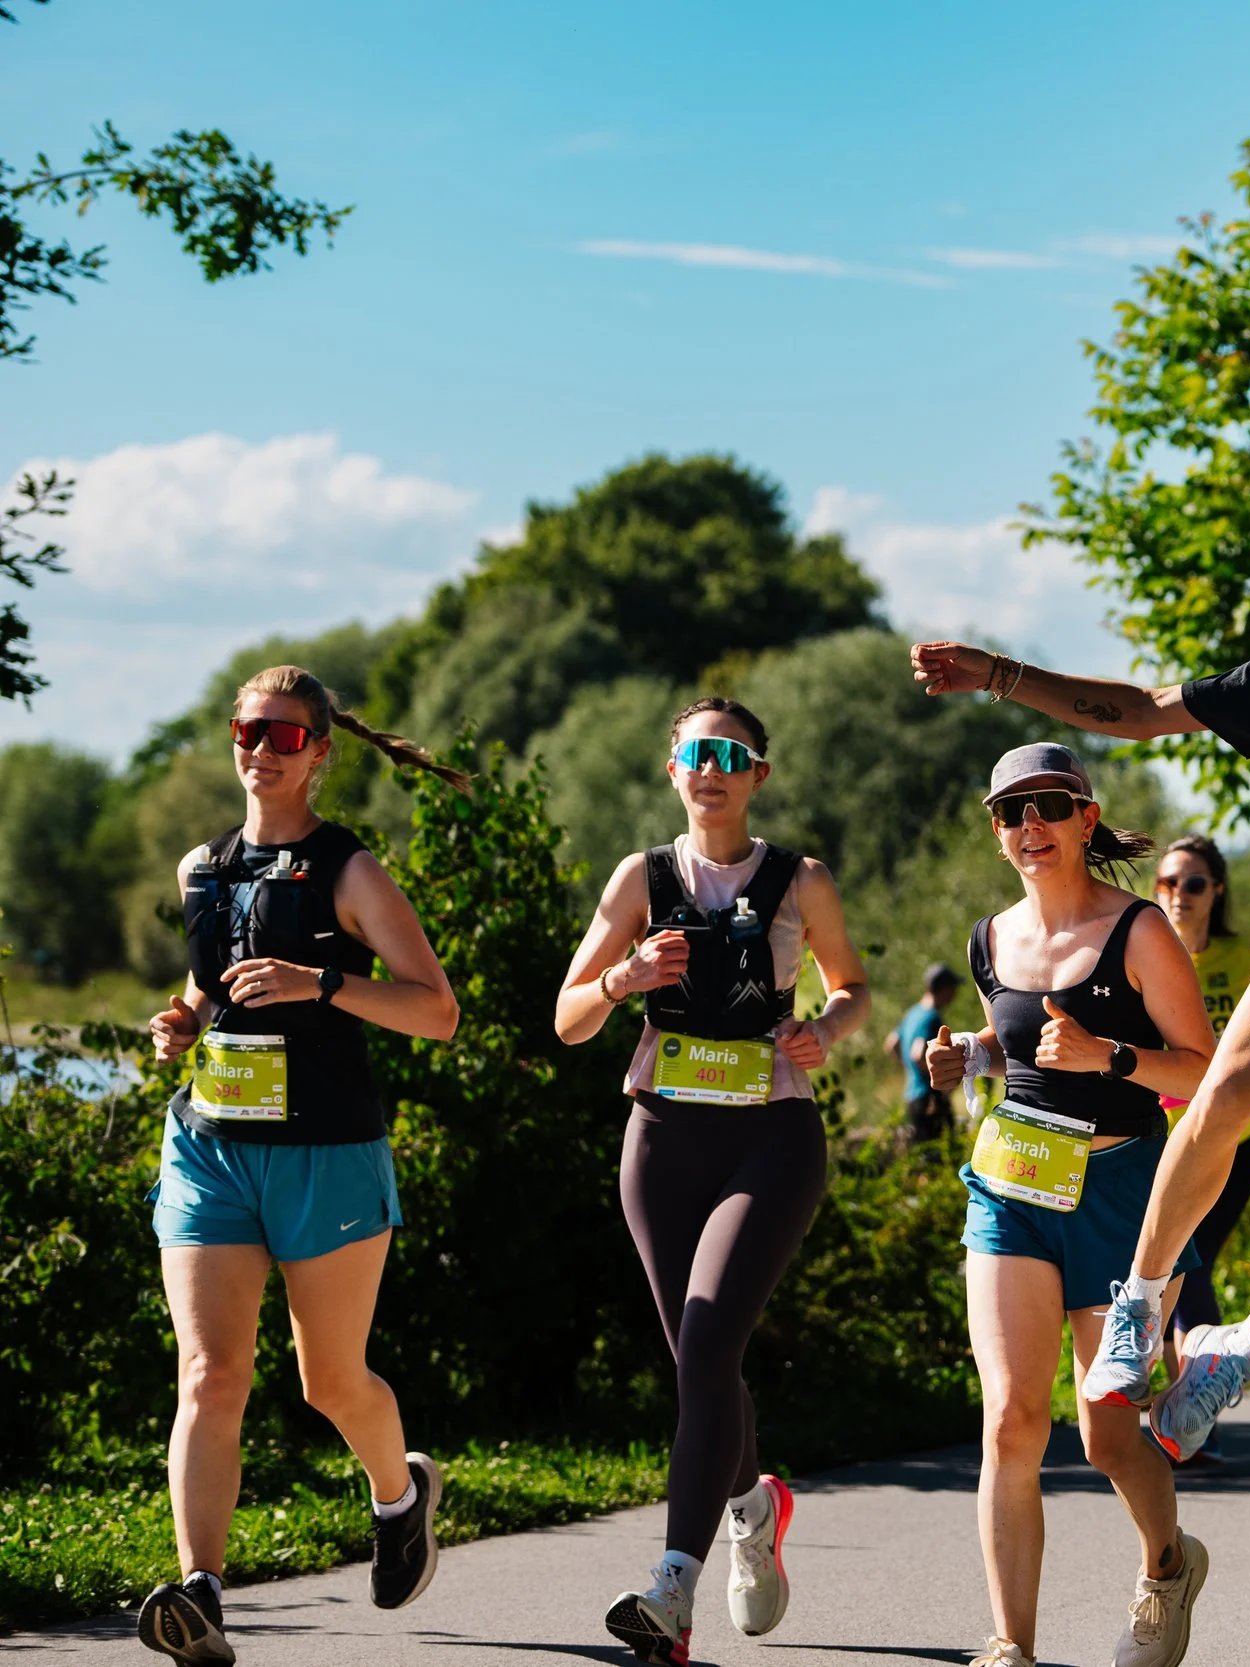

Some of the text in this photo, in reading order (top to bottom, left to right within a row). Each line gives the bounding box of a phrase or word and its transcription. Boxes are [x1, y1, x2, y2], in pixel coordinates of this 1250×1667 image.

[688, 1045, 739, 1065] Maria
[208, 1059, 254, 1079] Chiara
[696, 1067, 727, 1084] 401
[1003, 1132, 1050, 1161] Sarah
[1006, 1157, 1037, 1180] 634
